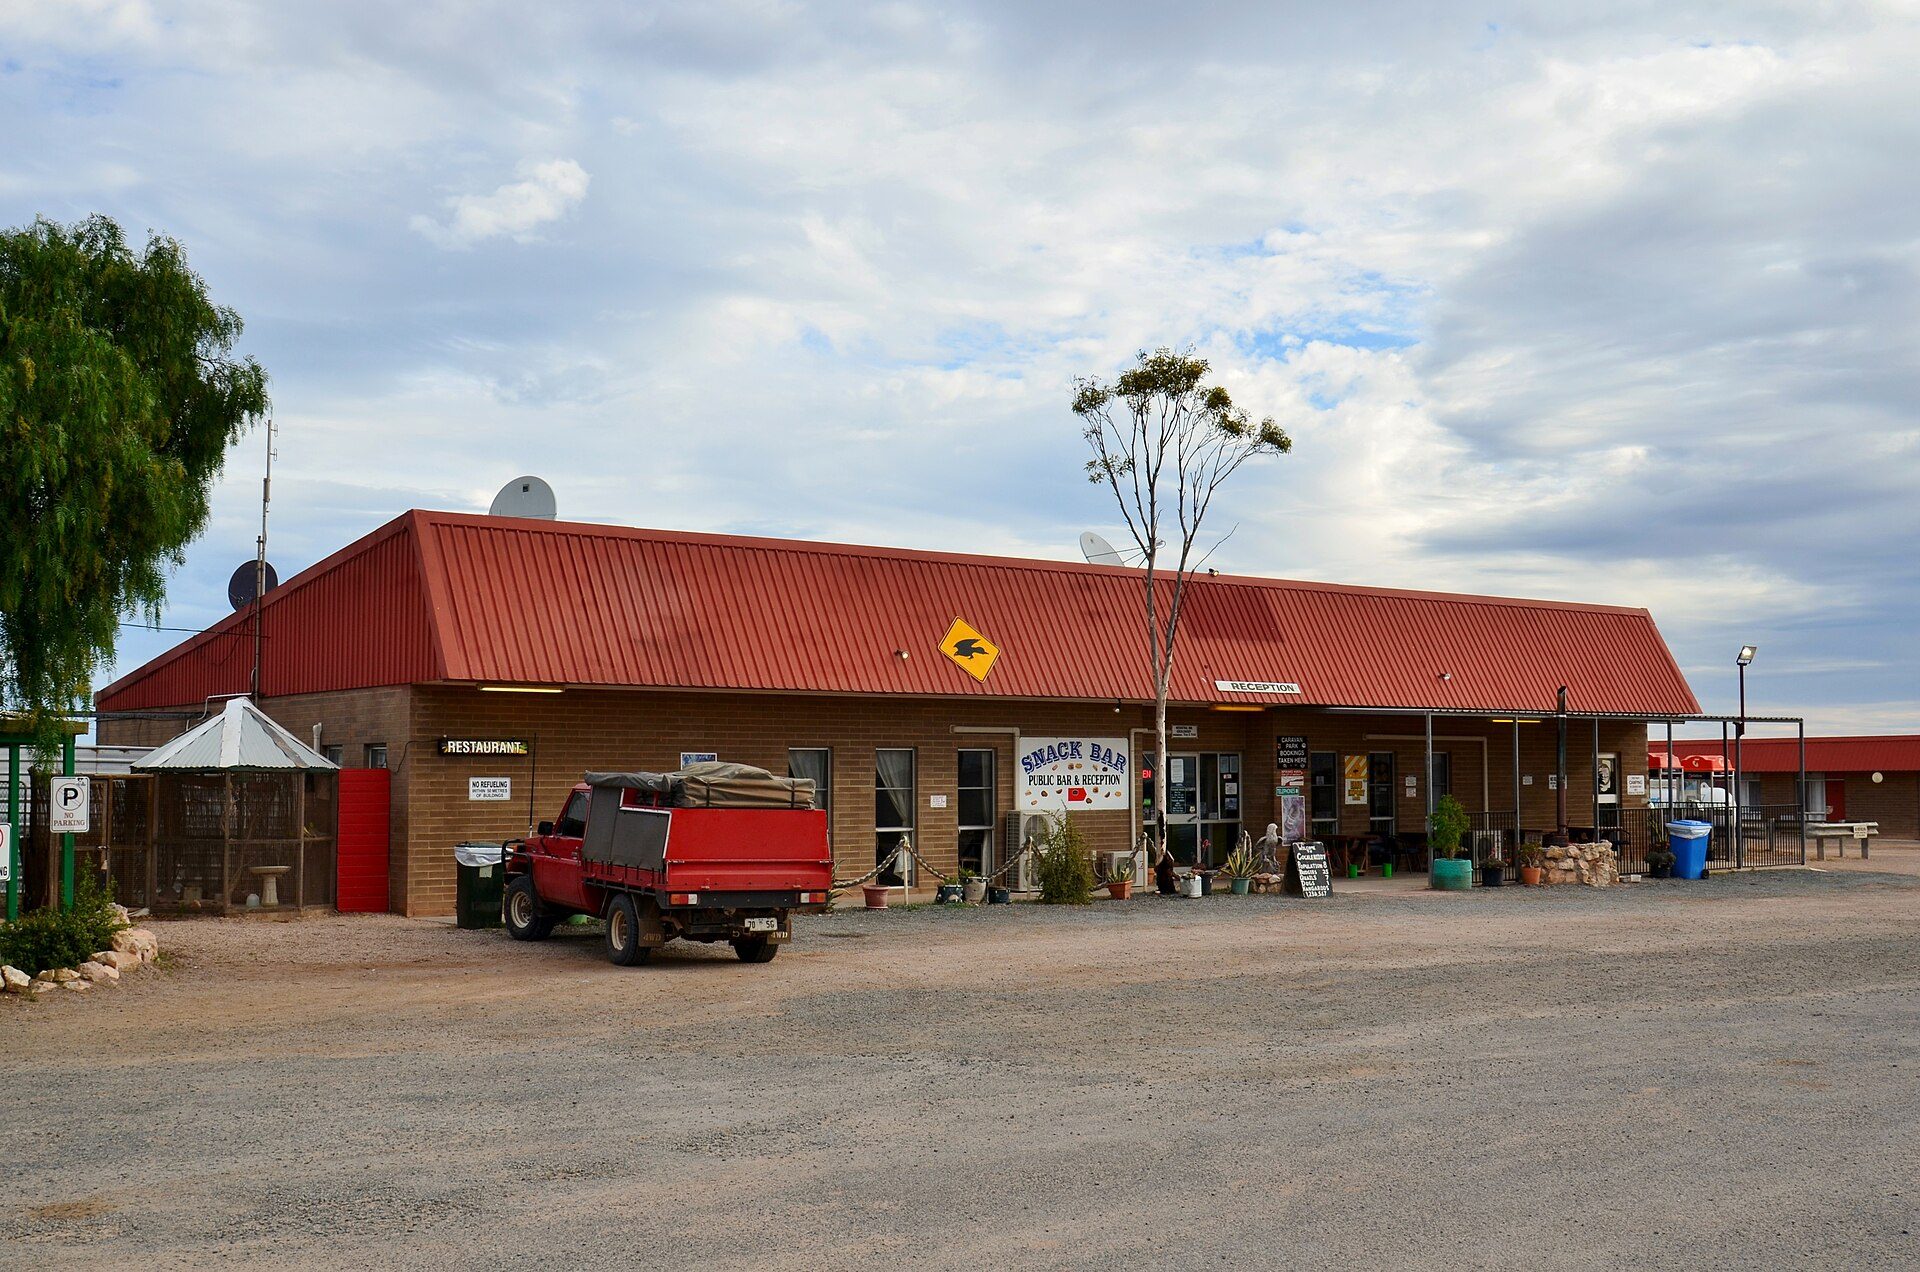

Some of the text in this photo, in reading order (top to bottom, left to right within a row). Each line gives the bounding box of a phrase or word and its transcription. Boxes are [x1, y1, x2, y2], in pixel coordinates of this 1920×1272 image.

[1231, 682, 1295, 692] RECEPTION
[447, 741, 521, 753] RESTAURANT
[1021, 741, 1127, 774] SNACK BAR
[1028, 774, 1121, 786] PUBLIC BAR & RECEPTION
[643, 933, 662, 941] 4WD
[771, 931, 788, 939] 4WD
